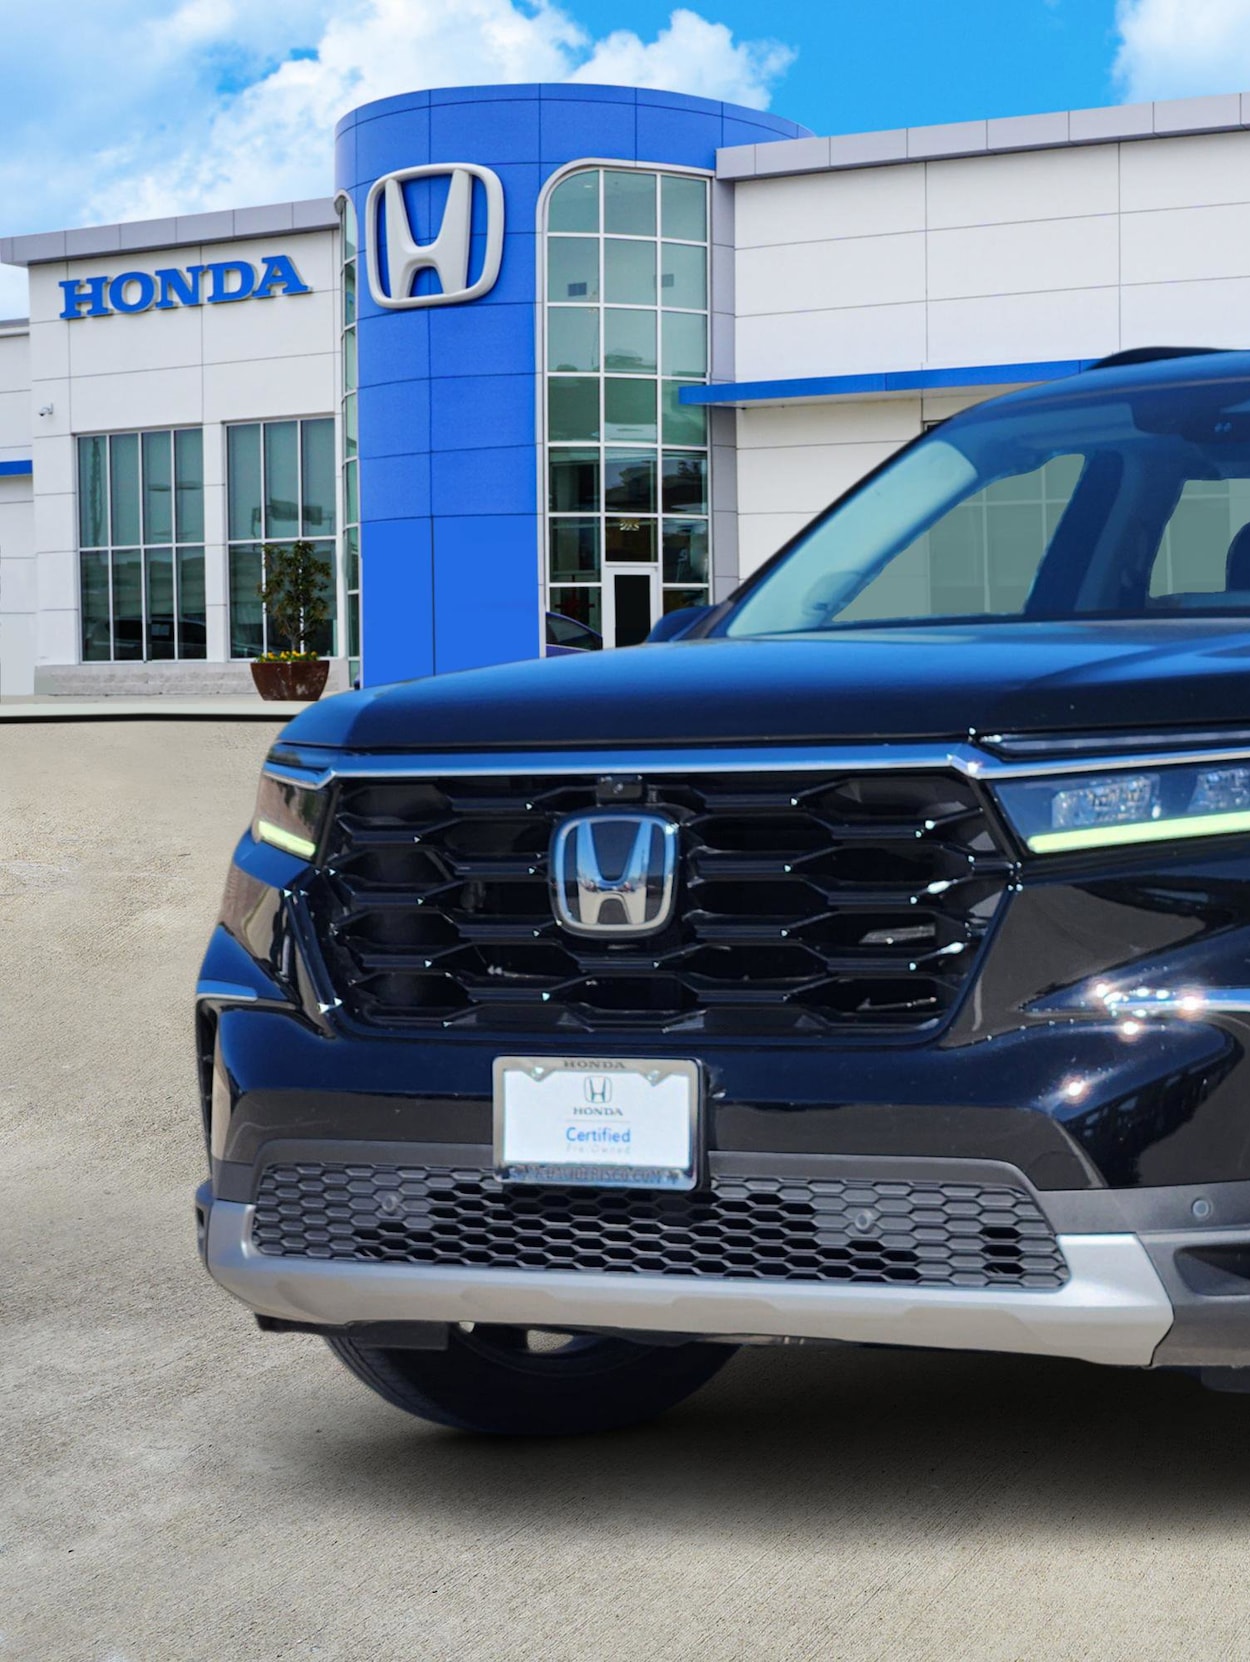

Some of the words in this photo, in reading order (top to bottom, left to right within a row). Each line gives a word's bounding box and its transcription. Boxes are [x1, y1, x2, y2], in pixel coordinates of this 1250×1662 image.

[58, 254, 312, 321] HONDA
[563, 1060, 626, 1069] HONDA
[573, 1107, 624, 1116] HONDA
[566, 1126, 631, 1142] Certified
